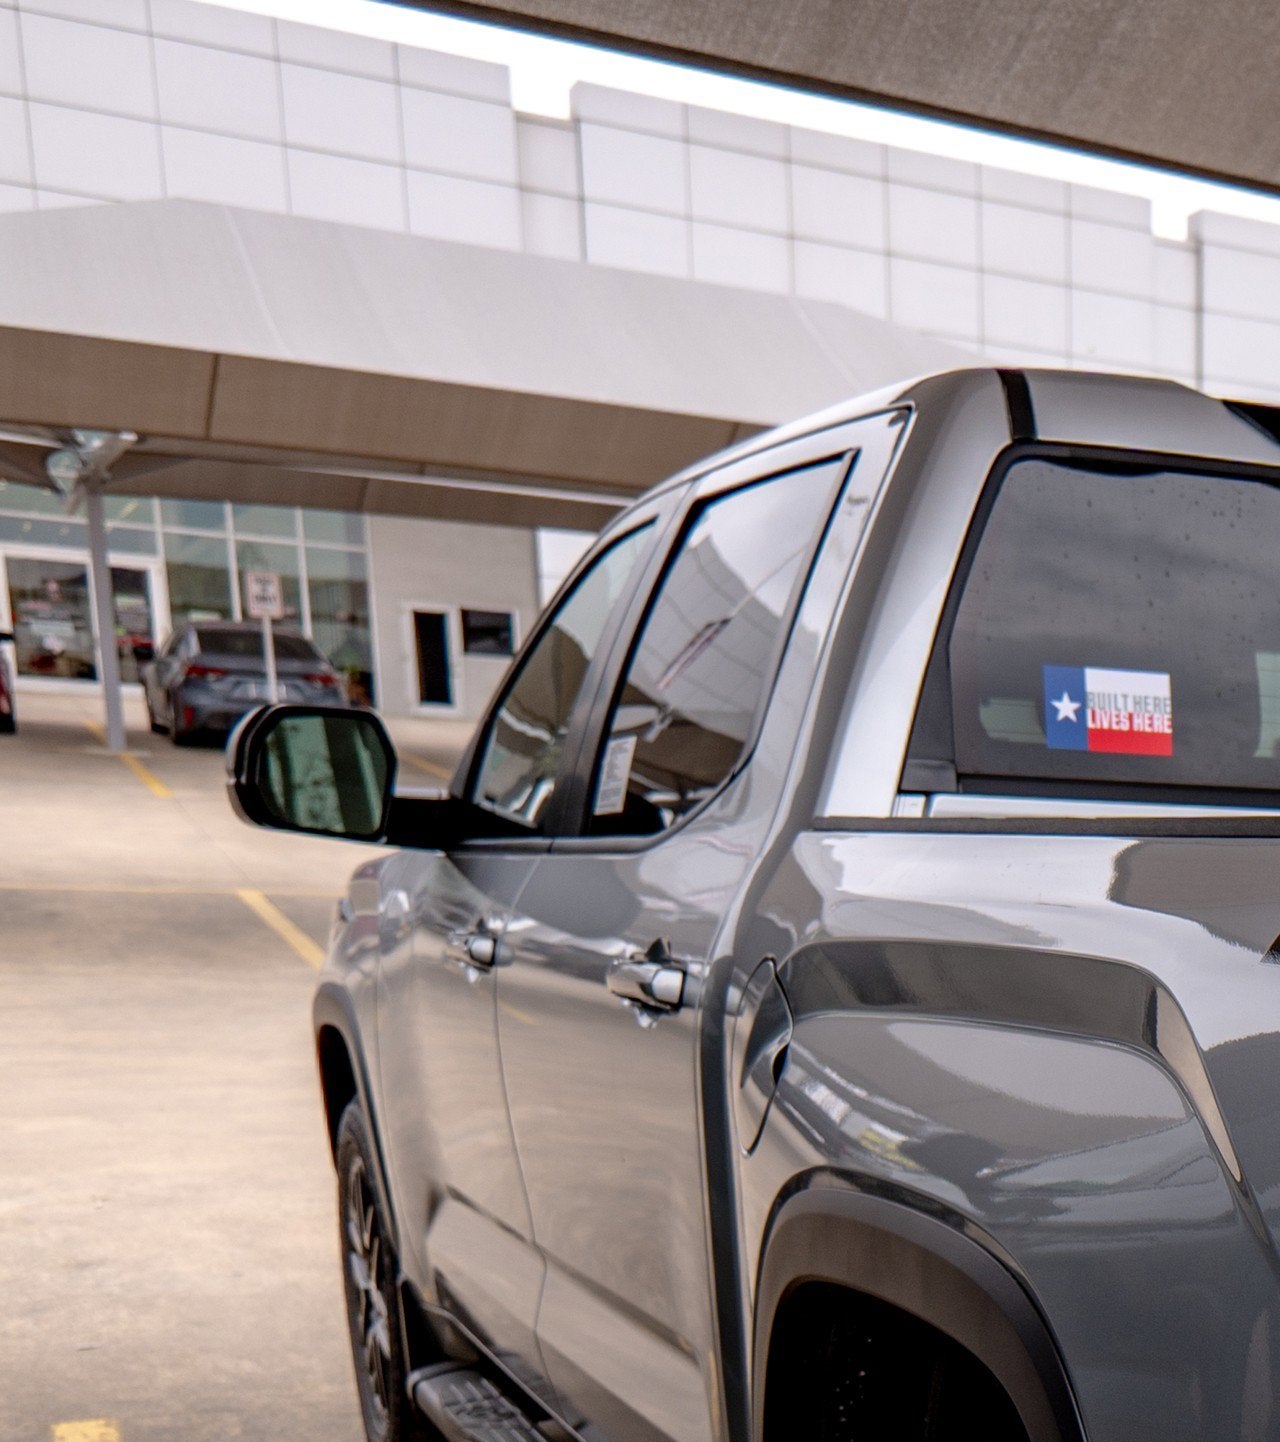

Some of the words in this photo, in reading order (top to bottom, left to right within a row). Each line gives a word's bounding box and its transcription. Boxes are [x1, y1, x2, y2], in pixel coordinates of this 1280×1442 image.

[1086, 692, 1129, 711] BUILT
[1133, 695, 1170, 715] HERE
[1087, 708, 1130, 731] LIVES
[1132, 712, 1172, 734] HERE
